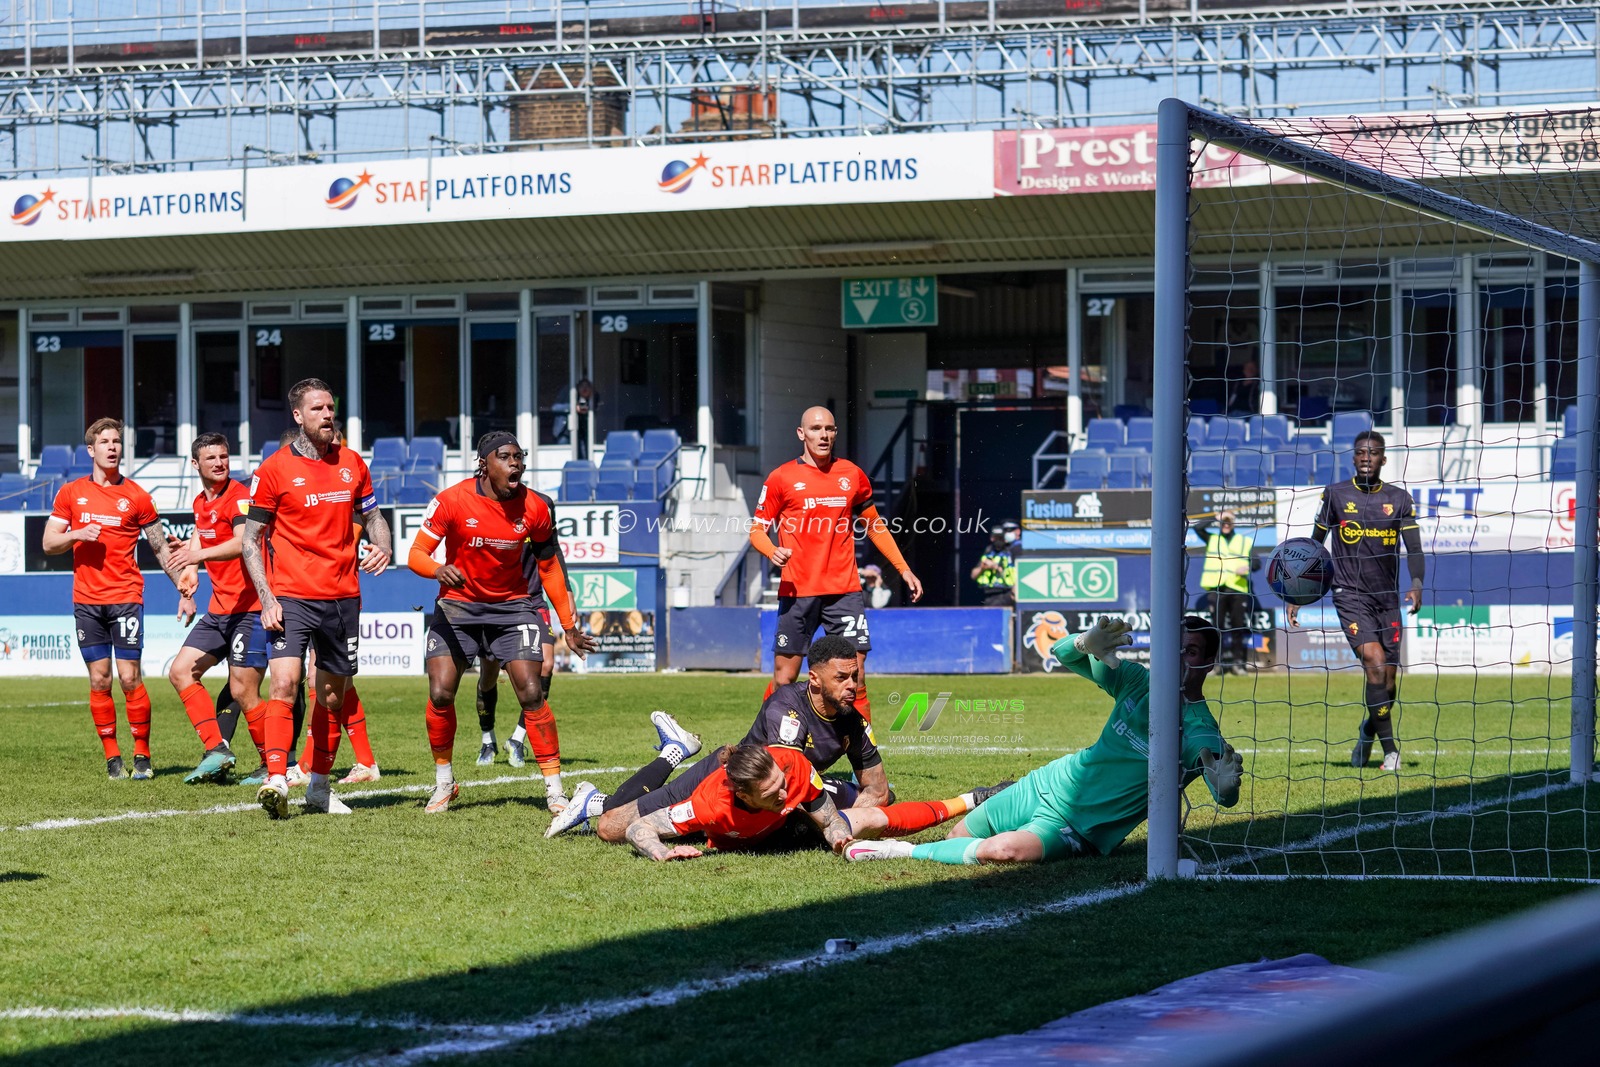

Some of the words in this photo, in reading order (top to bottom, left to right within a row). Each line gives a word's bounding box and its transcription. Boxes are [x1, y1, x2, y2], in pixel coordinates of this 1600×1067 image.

[1460, 143, 1550, 166] 01582
[712, 158, 918, 188] STARPLATFORMS
[1021, 174, 1081, 190] Design
[1084, 172, 1099, 186] &
[58, 191, 243, 220] STARPLATFORMS
[850, 281, 893, 297] EXIT
[907, 302, 919, 316] 5
[1087, 298, 1115, 316] 27
[368, 324, 395, 341] 25
[600, 315, 628, 333] 26
[36, 335, 61, 352] 23
[256, 329, 282, 346] 24
[304, 494, 319, 507] JB
[803, 498, 816, 509] JB
[1026, 499, 1073, 518] Fusion
[79, 512, 91, 522] JB
[468, 536, 484, 547] JB
[1056, 533, 1101, 545] Installers
[1103, 532, 1114, 544] of
[1116, 532, 1150, 546] quality
[1344, 527, 1397, 539] Sportsbet.io
[1088, 569, 1103, 592] 5
[118, 617, 139, 638] 19
[360, 619, 413, 639] uton
[841, 614, 869, 636] 24
[22, 634, 71, 648] PHONES
[232, 633, 245, 653] 6
[517, 624, 540, 647] 17
[22, 649, 71, 660] 2POUNDS
[358, 652, 411, 669] stering
